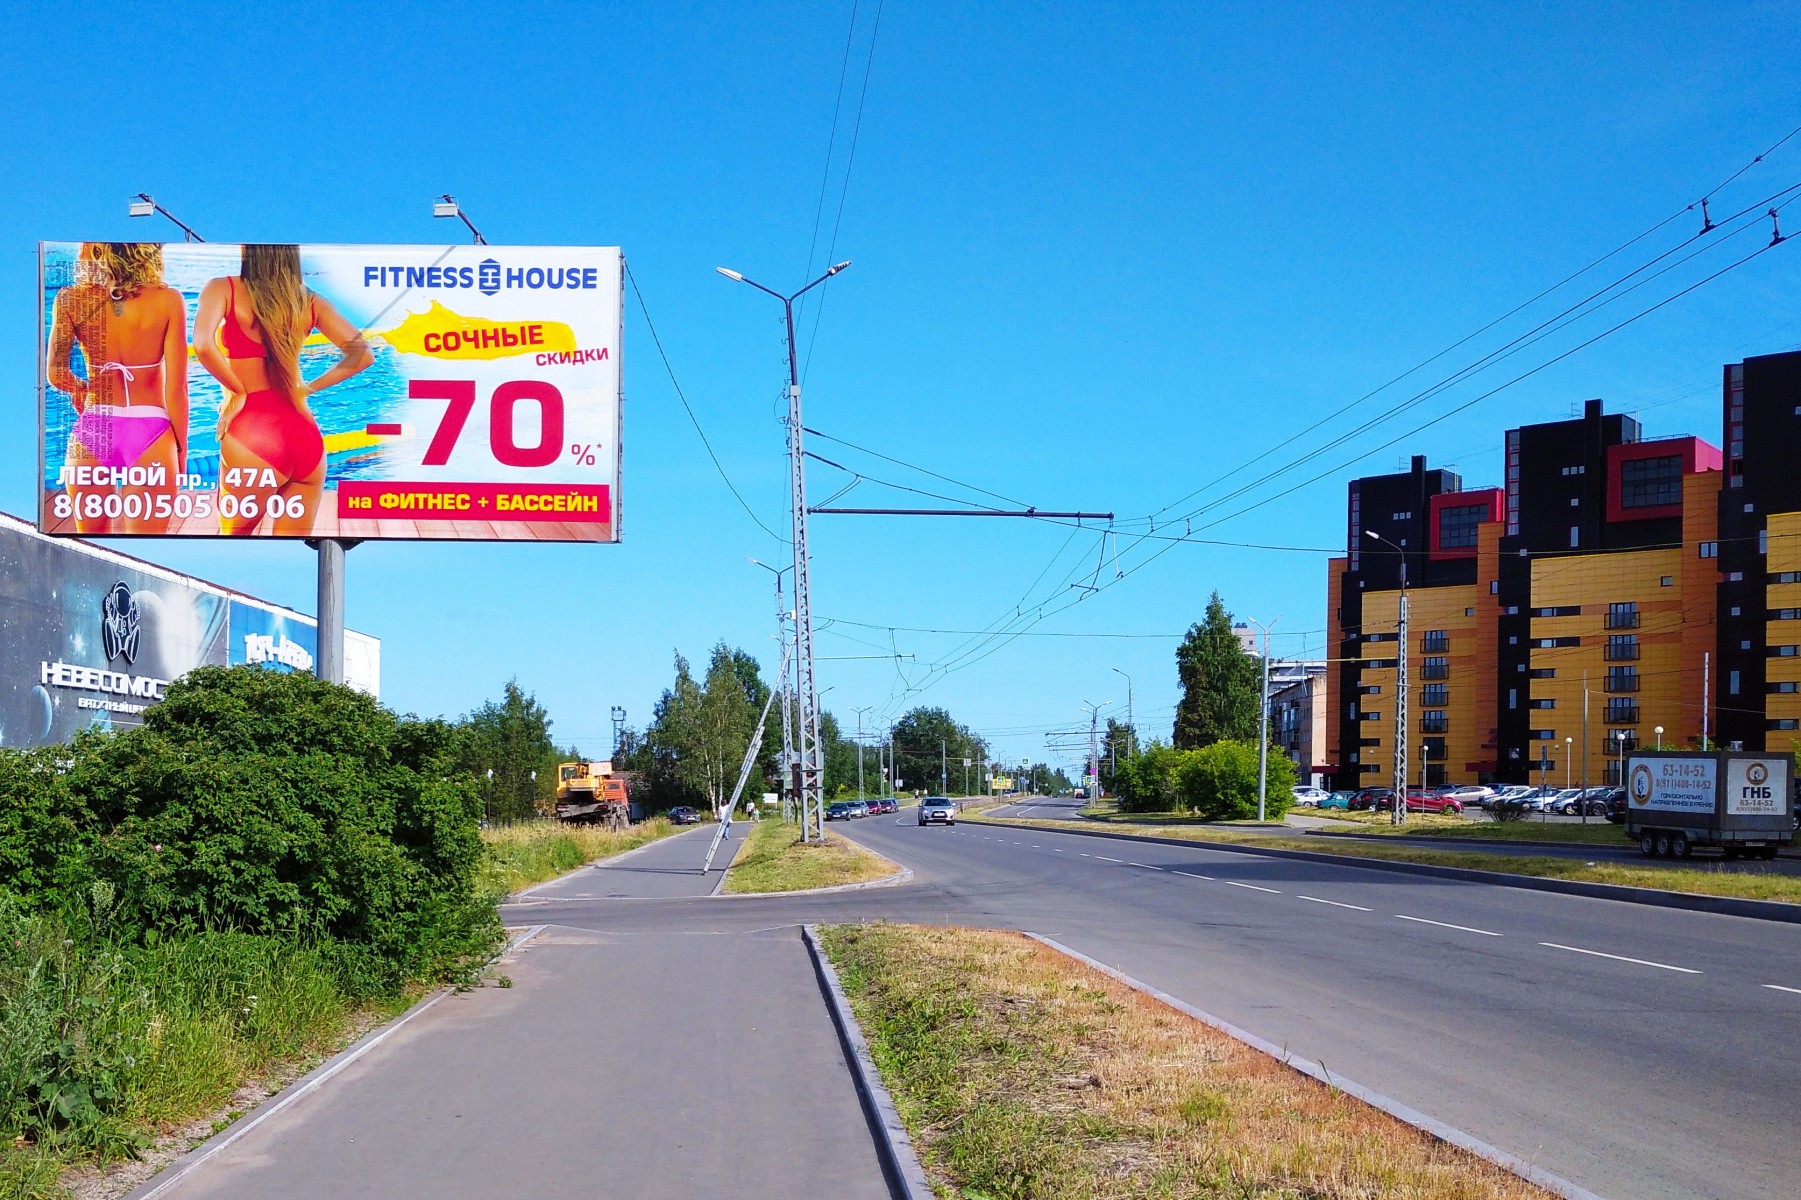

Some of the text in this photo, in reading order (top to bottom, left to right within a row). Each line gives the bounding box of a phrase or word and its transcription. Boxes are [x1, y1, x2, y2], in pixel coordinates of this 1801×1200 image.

[364, 266, 598, 289] FITNESS HOUSE
[424, 324, 544, 353] СОЧНЫЕ
[56, 462, 166, 486] ЛЕСНОЙ
[225, 468, 278, 488] 47А
[53, 492, 305, 521] 8(800)505 06 06
[348, 491, 598, 512] на ФИТНЕС + БАССЕЙН
[1663, 764, 1705, 777] 63-14-52
[1742, 787, 1772, 799] ГНБ
